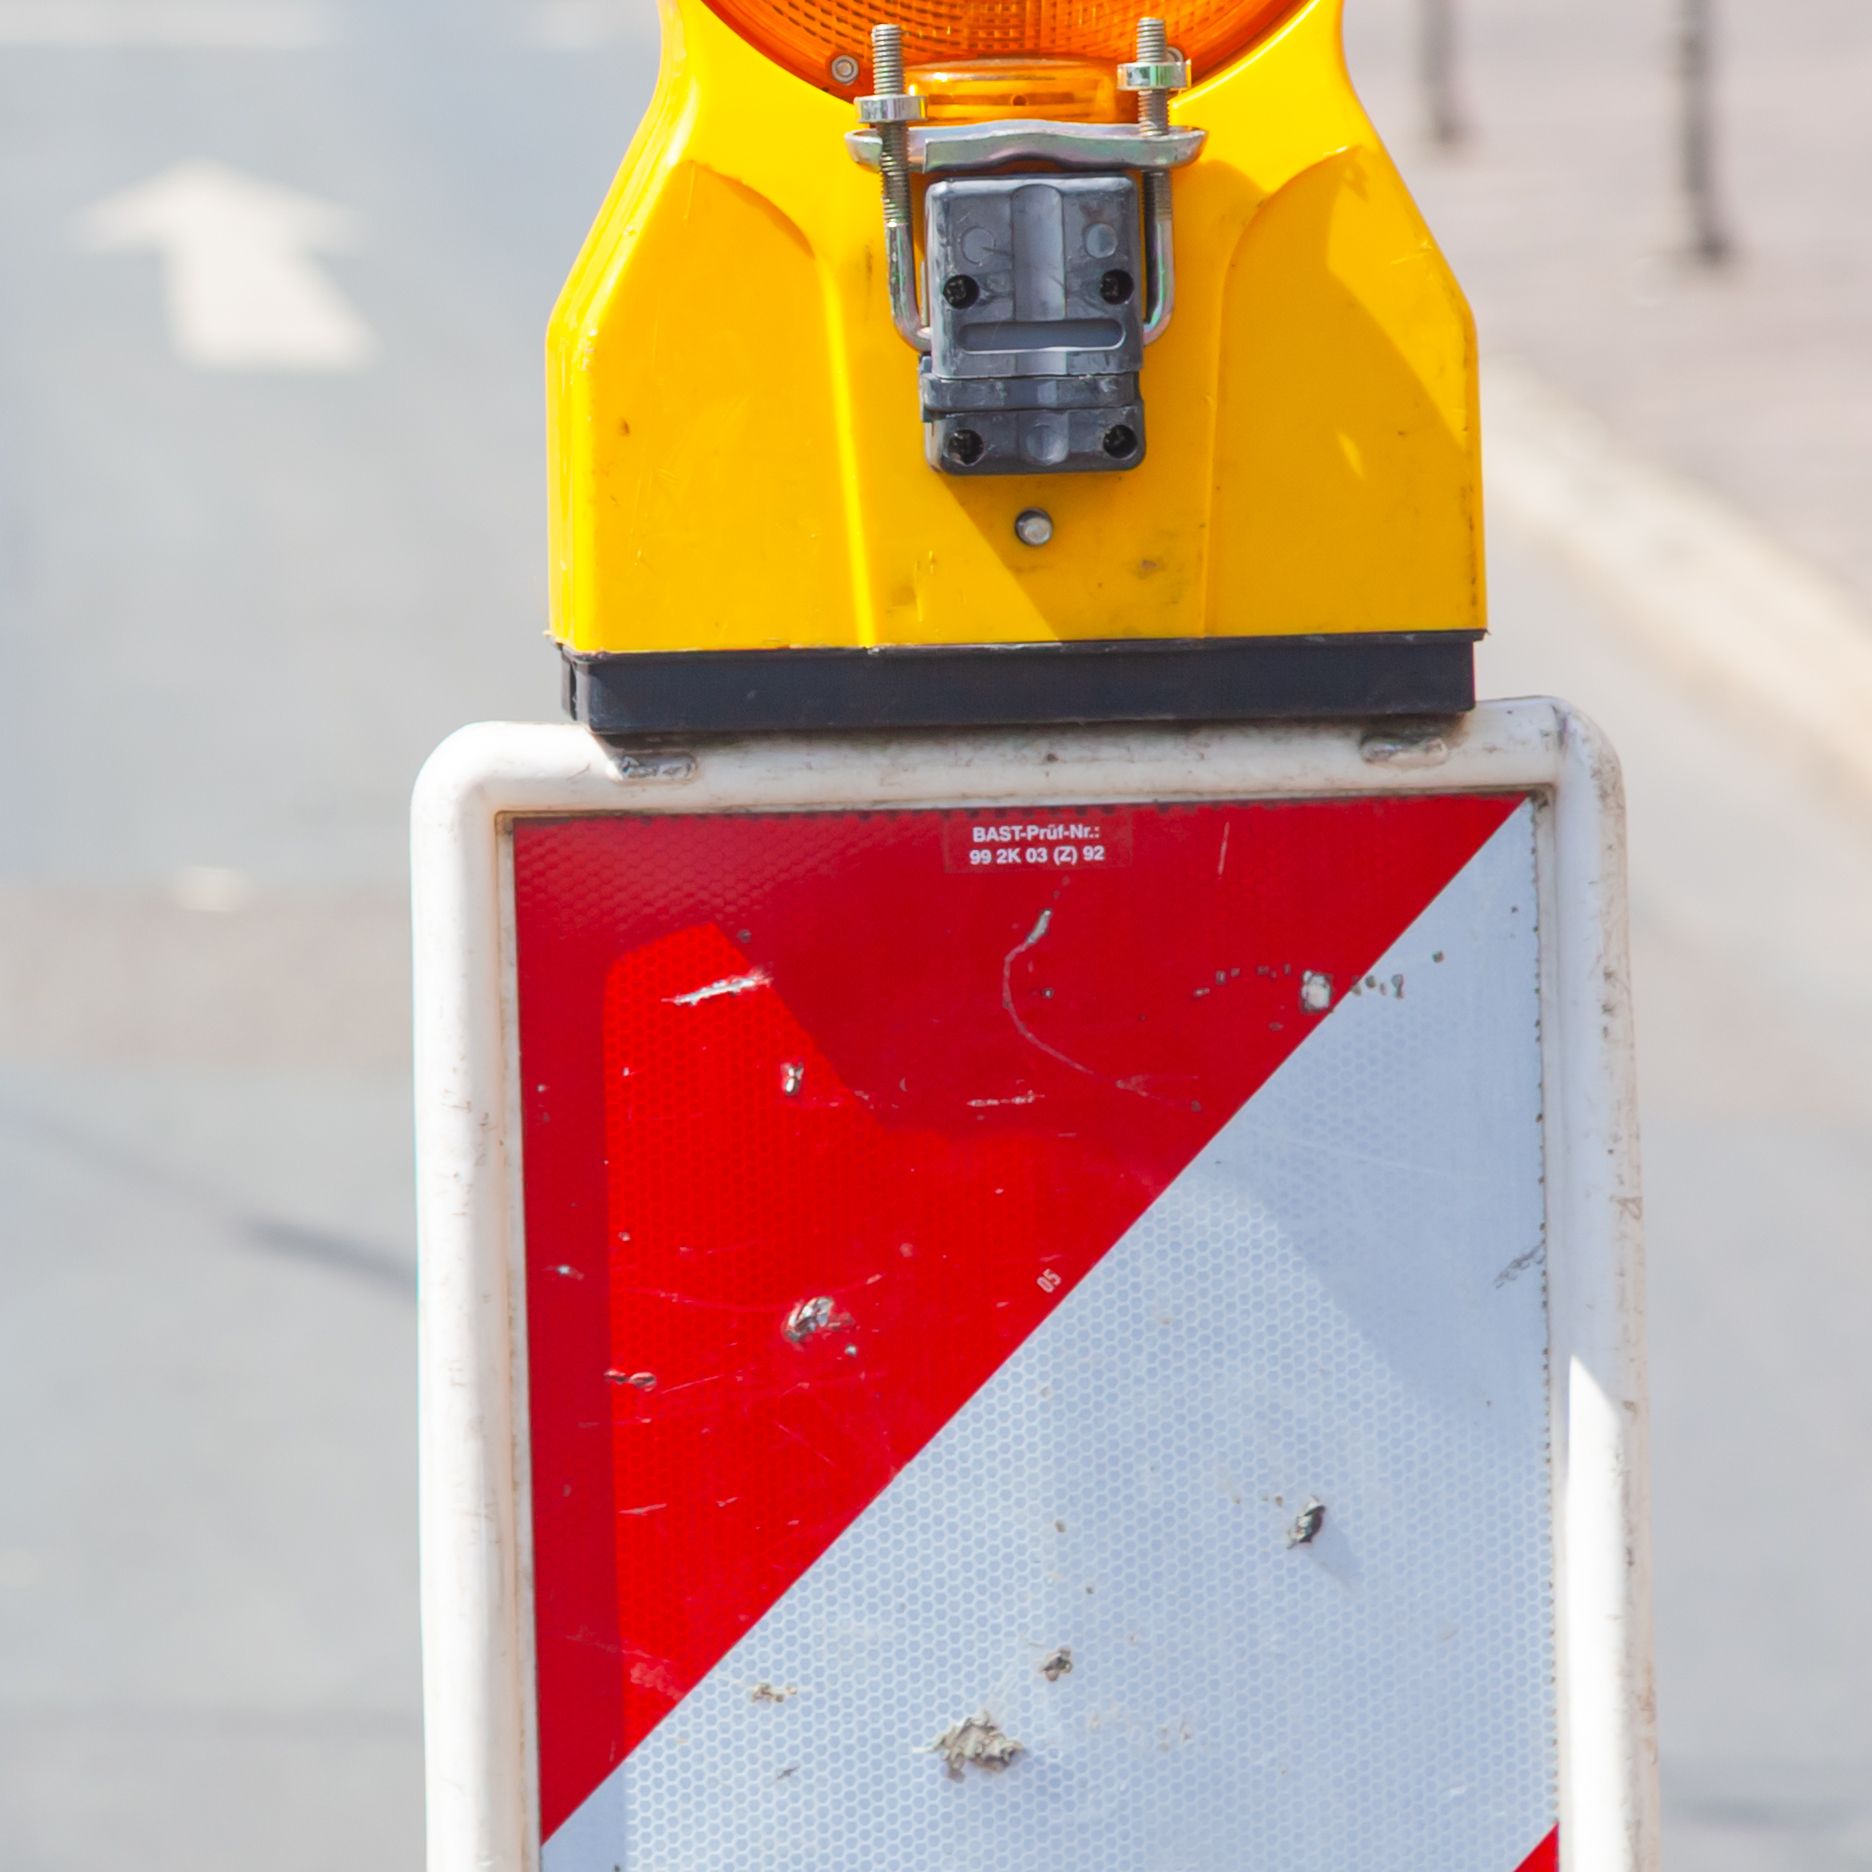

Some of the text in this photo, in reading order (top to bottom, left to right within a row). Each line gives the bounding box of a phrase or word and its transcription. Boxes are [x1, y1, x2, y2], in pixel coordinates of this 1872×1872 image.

[972, 823, 1100, 843] BAST-Prüf-Nr.:
[969, 845, 1105, 866] 99 2K 03 (Z) 92
[1036, 1268, 1062, 1293] 05
